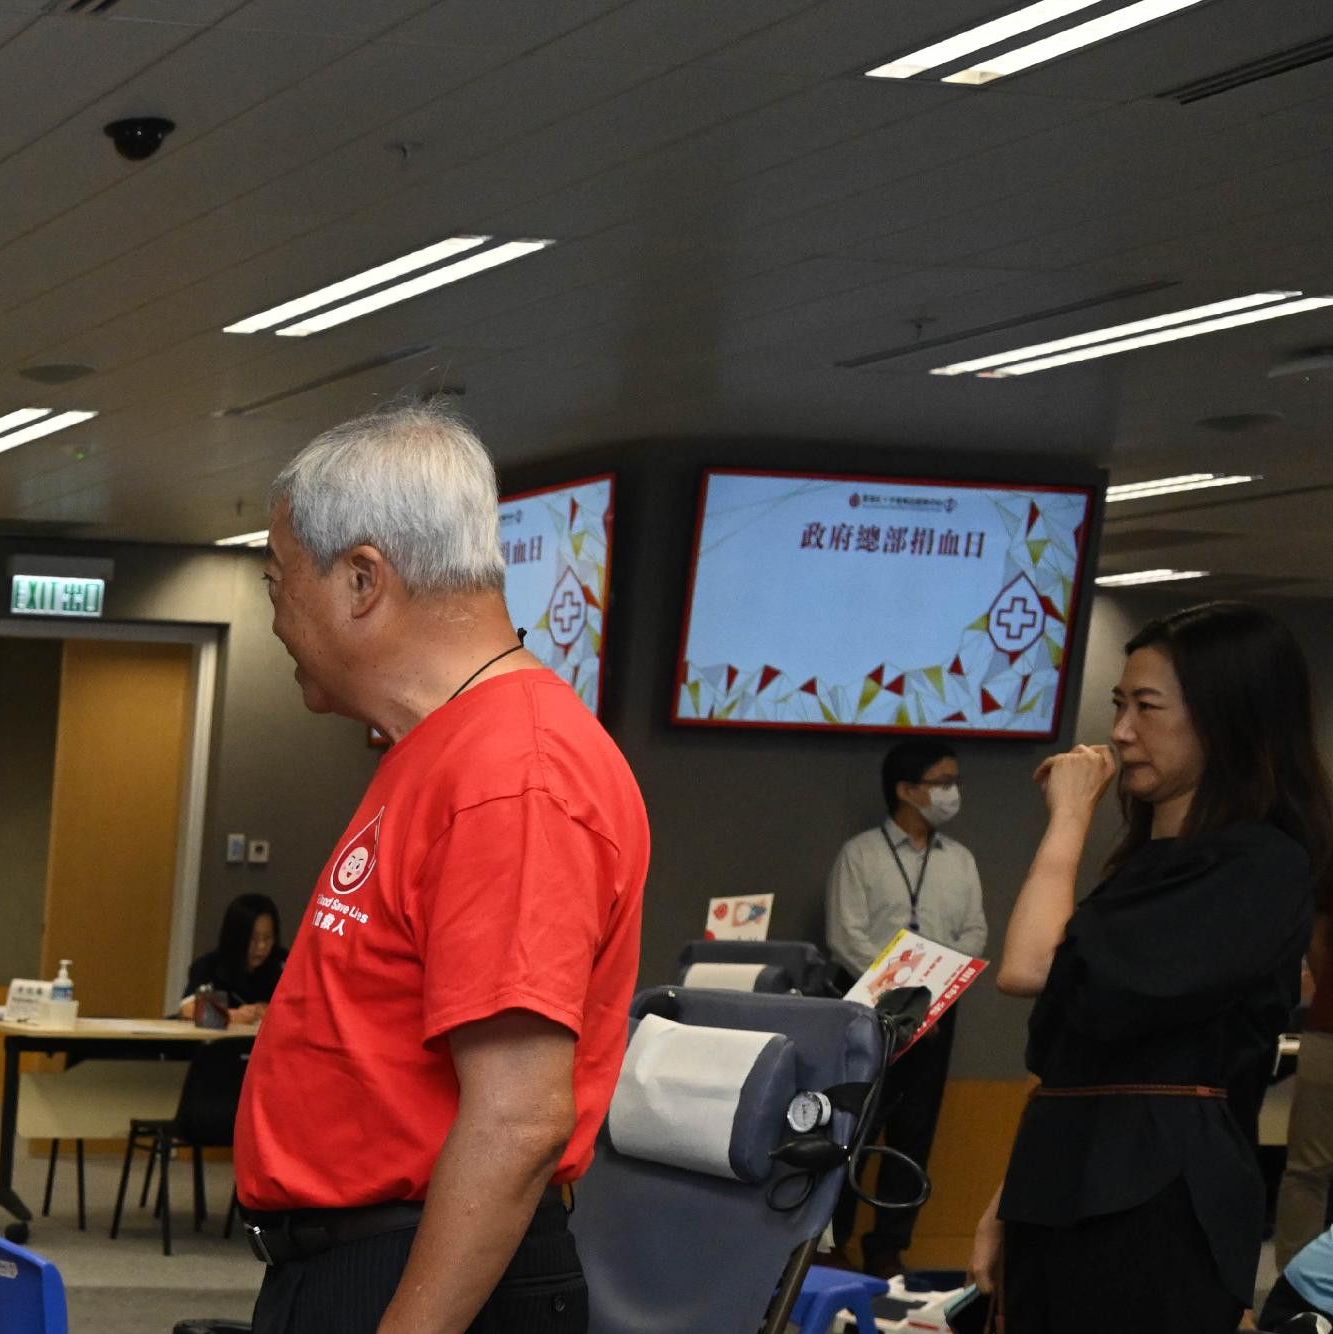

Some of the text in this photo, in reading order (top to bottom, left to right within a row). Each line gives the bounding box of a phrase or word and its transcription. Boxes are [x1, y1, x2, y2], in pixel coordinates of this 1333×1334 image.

[801, 522, 986, 558] 政府總部捐血日
[14, 580, 100, 613] EXIT 出口
